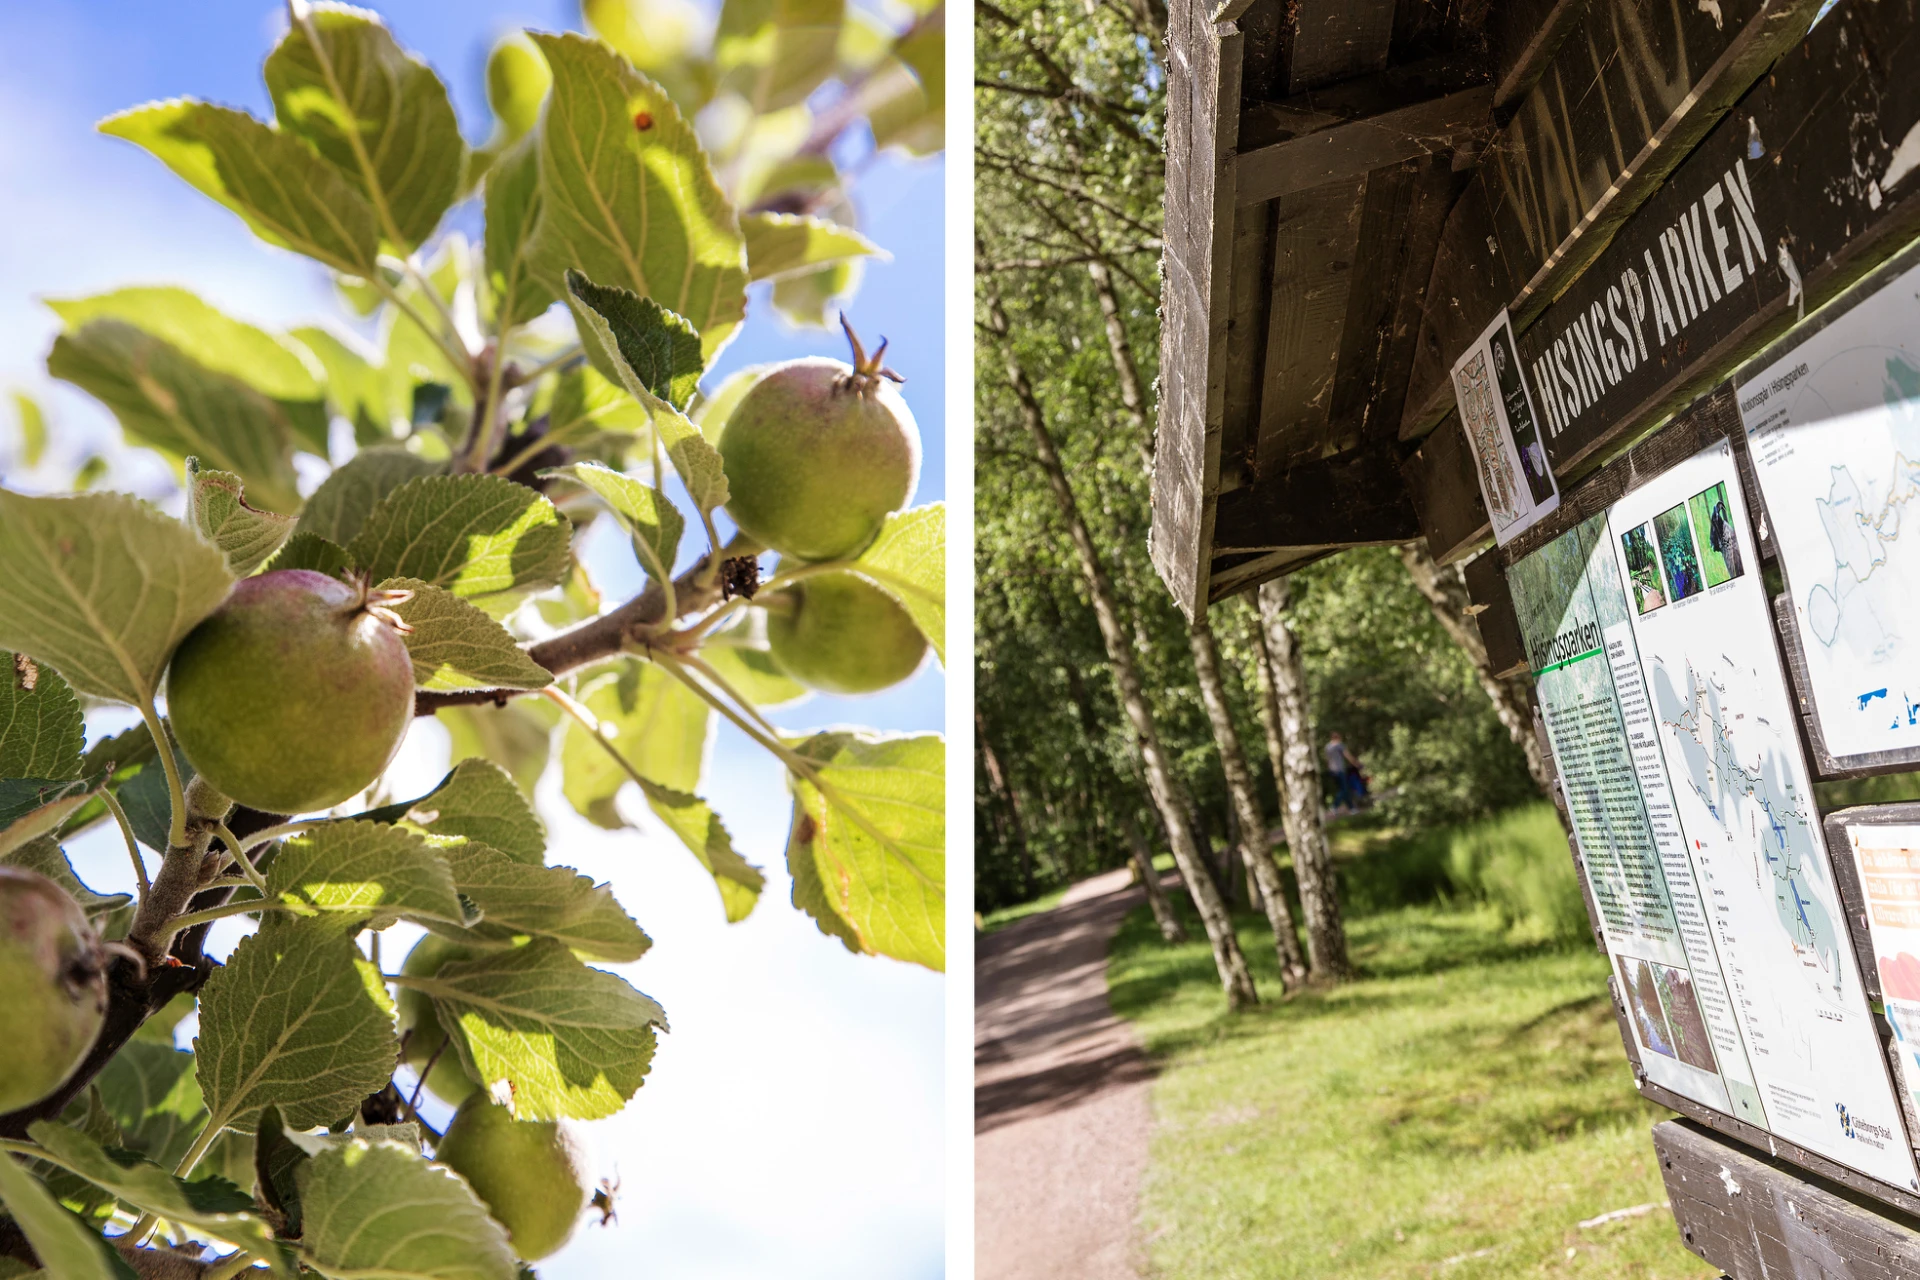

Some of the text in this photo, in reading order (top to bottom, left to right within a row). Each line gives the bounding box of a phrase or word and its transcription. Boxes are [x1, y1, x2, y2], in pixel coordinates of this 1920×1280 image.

[1532, 158, 1767, 438] HISINGSPARKEN
[1771, 362, 1810, 395] Hisingsparken
[1529, 617, 1601, 671] Hisingsparken
[1851, 1115, 1893, 1140] Göteborgs Stad
